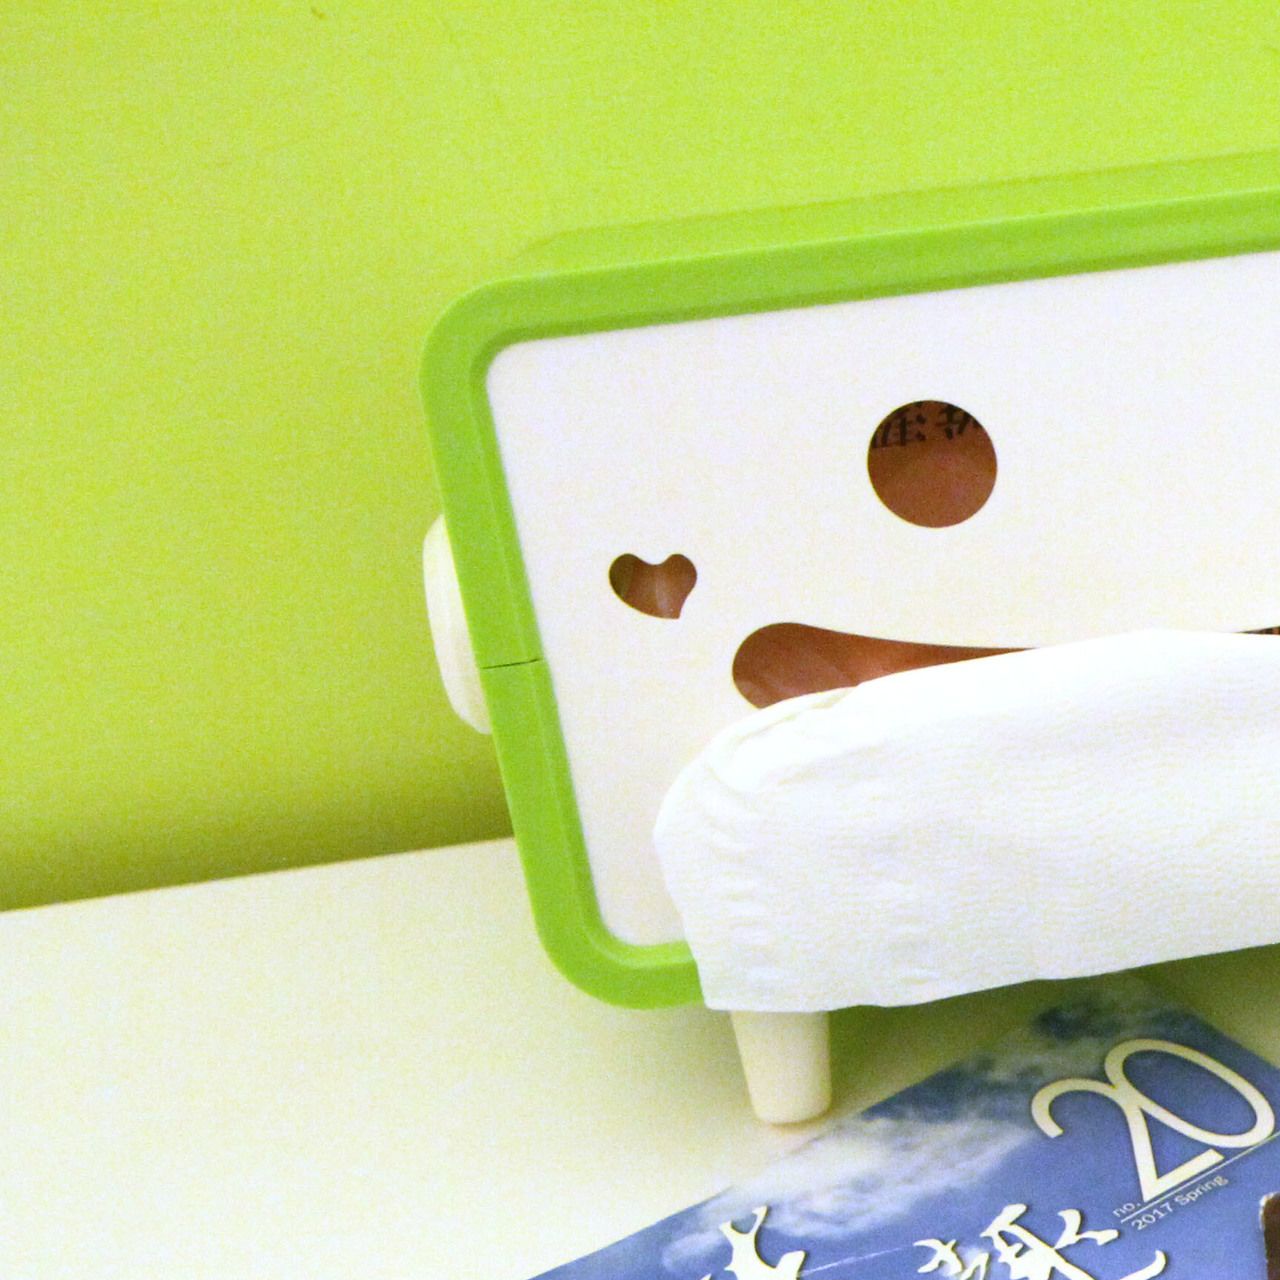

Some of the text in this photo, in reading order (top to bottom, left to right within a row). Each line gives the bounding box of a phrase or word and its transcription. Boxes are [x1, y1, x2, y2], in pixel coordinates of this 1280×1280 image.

[1031, 1038, 1275, 1203] 20
[1113, 1200, 1141, 1219] no.
[1130, 1175, 1229, 1230] 2017 Spring
